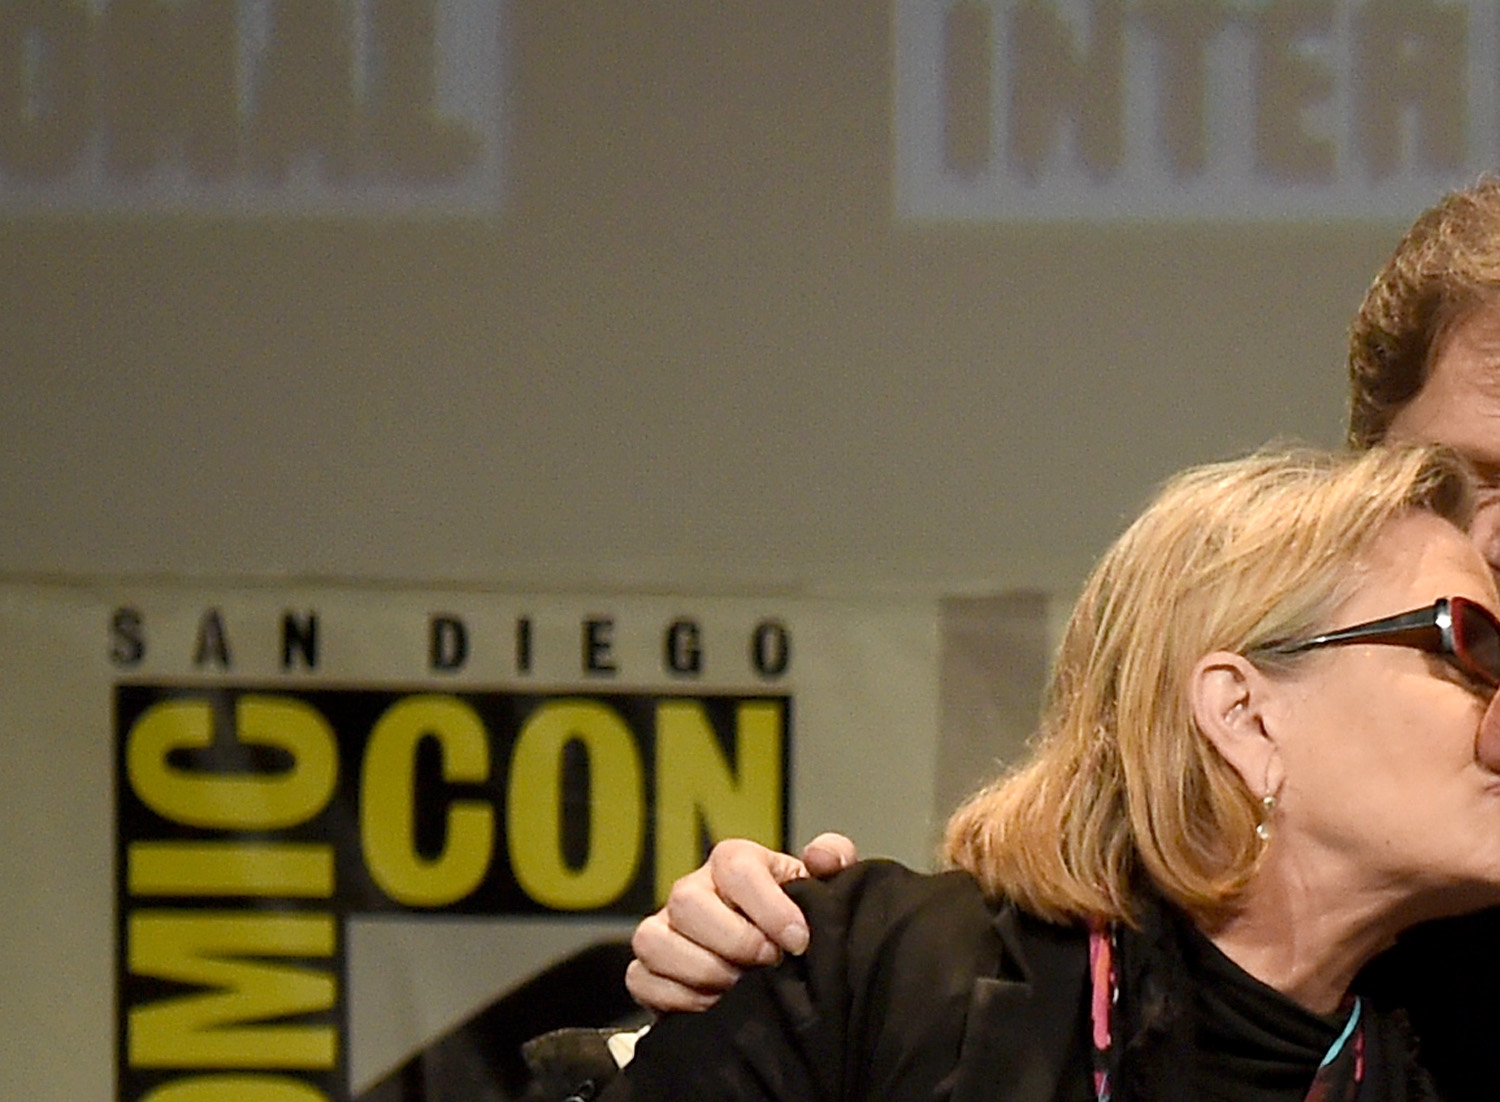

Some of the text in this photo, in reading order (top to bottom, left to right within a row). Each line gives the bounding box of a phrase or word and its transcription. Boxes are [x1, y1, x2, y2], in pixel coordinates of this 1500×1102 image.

[109, 607, 790, 680] SAN DIEGO
[360, 694, 784, 911] CON
